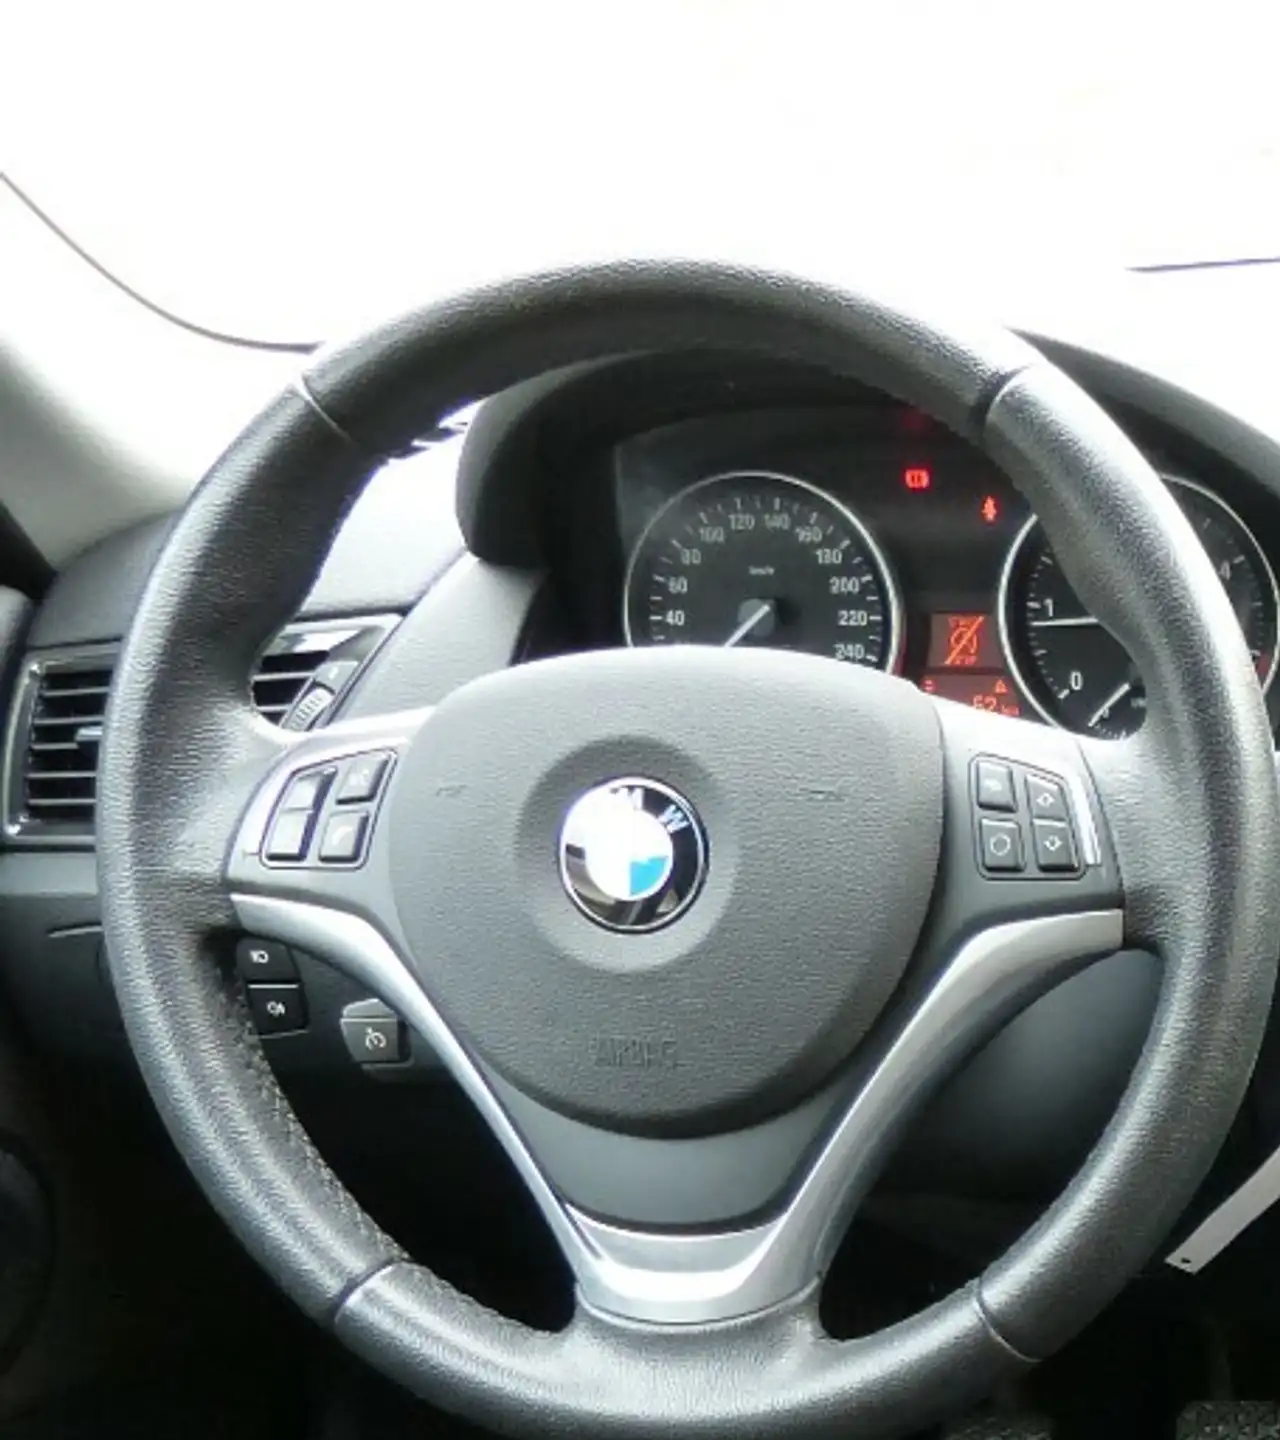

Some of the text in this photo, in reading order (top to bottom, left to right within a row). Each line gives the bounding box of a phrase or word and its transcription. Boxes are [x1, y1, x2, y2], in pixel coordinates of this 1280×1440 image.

[728, 513, 755, 530] 120
[764, 514, 791, 531] 140
[816, 549, 843, 565] 180
[667, 576, 689, 595] 60
[830, 576, 860, 594] 200
[1043, 597, 1053, 617] 1
[665, 610, 685, 626] 40
[838, 610, 868, 627] 220
[833, 643, 864, 661] 240
[1070, 672, 1083, 691] 0
